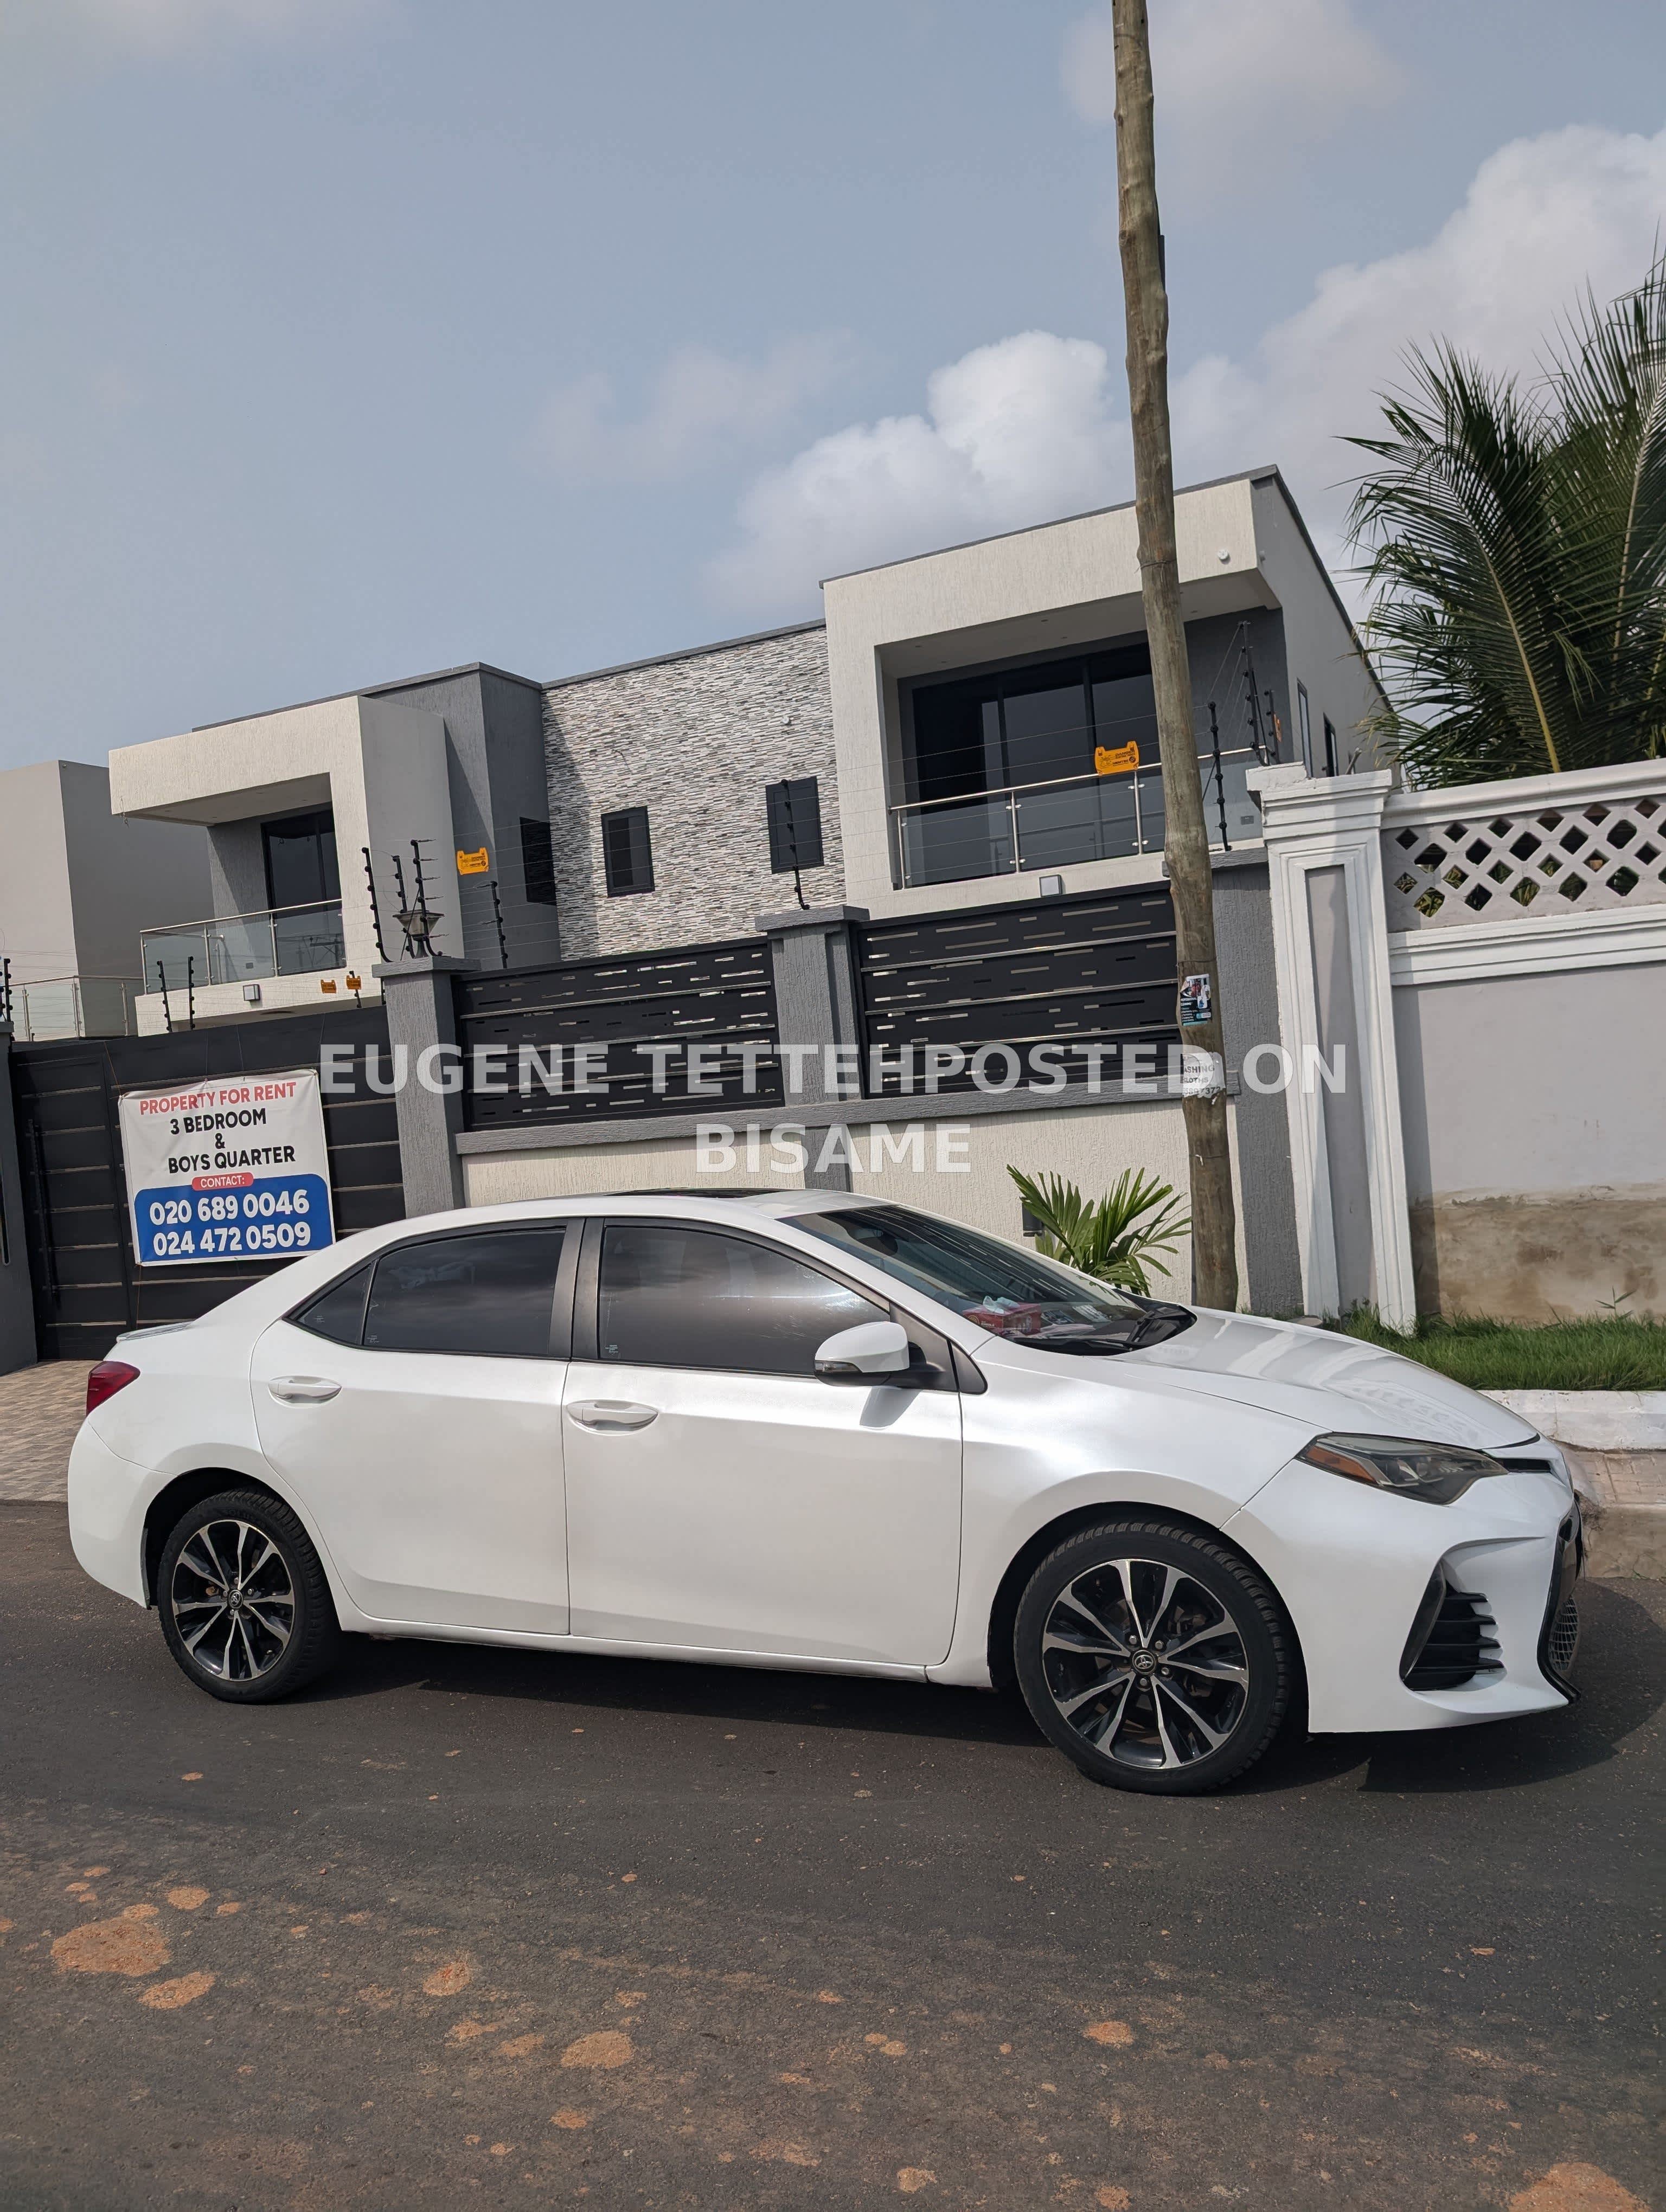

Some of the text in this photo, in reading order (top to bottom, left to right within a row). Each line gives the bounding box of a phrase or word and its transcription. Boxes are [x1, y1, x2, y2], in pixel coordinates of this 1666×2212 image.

[1184, 1064, 1214, 1073] ASHING
[140, 1082, 296, 1115] PROPERTY FOR RENT
[170, 1108, 266, 1134] 3 BEDROOM
[215, 1133, 225, 1149] &
[168, 1146, 295, 1173] BOYS QUARTER
[200, 1176, 245, 1188] CONTACT:
[150, 1189, 309, 1225] 020 689 0046
[153, 1221, 311, 1256] 024 472 0509
